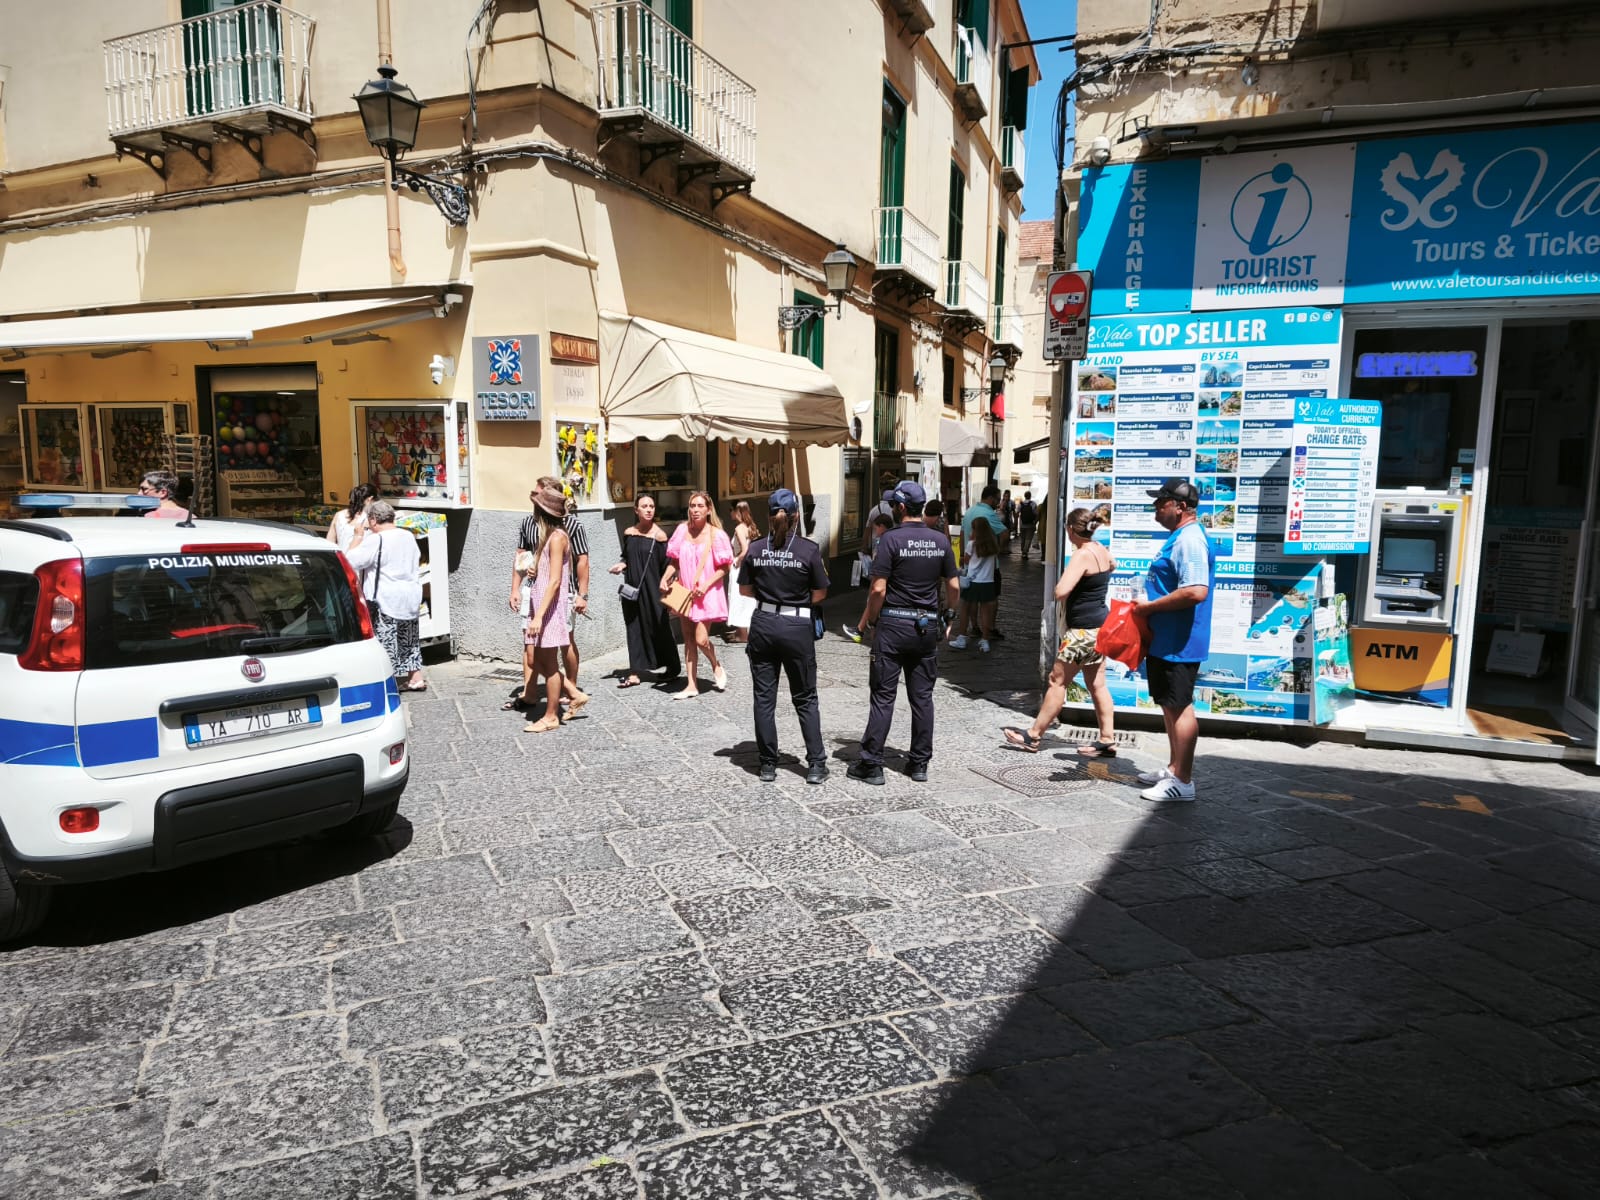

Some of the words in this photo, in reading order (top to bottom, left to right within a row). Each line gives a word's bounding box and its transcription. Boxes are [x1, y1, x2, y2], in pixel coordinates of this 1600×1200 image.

[1125, 168, 1147, 308] EXCHANGE
[1412, 238, 1485, 263] Tours
[1494, 234, 1515, 258] &
[1221, 255, 1317, 280] TOURIST
[1216, 278, 1319, 296] INFORMATIONS
[1097, 324, 1133, 342] Vale
[1137, 323, 1180, 346] TOP
[1185, 319, 1267, 345] SELLER
[1079, 357, 1092, 367] BY
[1094, 356, 1123, 366] LAND
[1201, 352, 1216, 362] BY
[1217, 351, 1239, 361] SEA
[477, 391, 536, 409] TESORI
[1340, 404, 1378, 414] AUTHORIZED
[1341, 415, 1375, 424] CURRENCY
[1307, 434, 1340, 444] CHANGE
[1343, 435, 1367, 445] RATES
[907, 540, 936, 549] Polizia
[1303, 543, 1312, 551] NO
[1313, 543, 1355, 551] COMMISSION
[761, 549, 794, 559] Polizia
[899, 549, 945, 558] Municipale
[148, 556, 213, 569] POLIZIA
[215, 554, 302, 567] MUNICIPALE
[753, 558, 802, 569] Municipale
[1215, 563, 1236, 573] 24H
[1238, 563, 1278, 573] BEFORE
[1231, 583, 1268, 591] POSITANO
[1366, 643, 1419, 660] ATM
[246, 663, 261, 675] FIAT
[208, 720, 228, 737] YA
[247, 713, 272, 731] 710
[287, 708, 304, 725] AR
